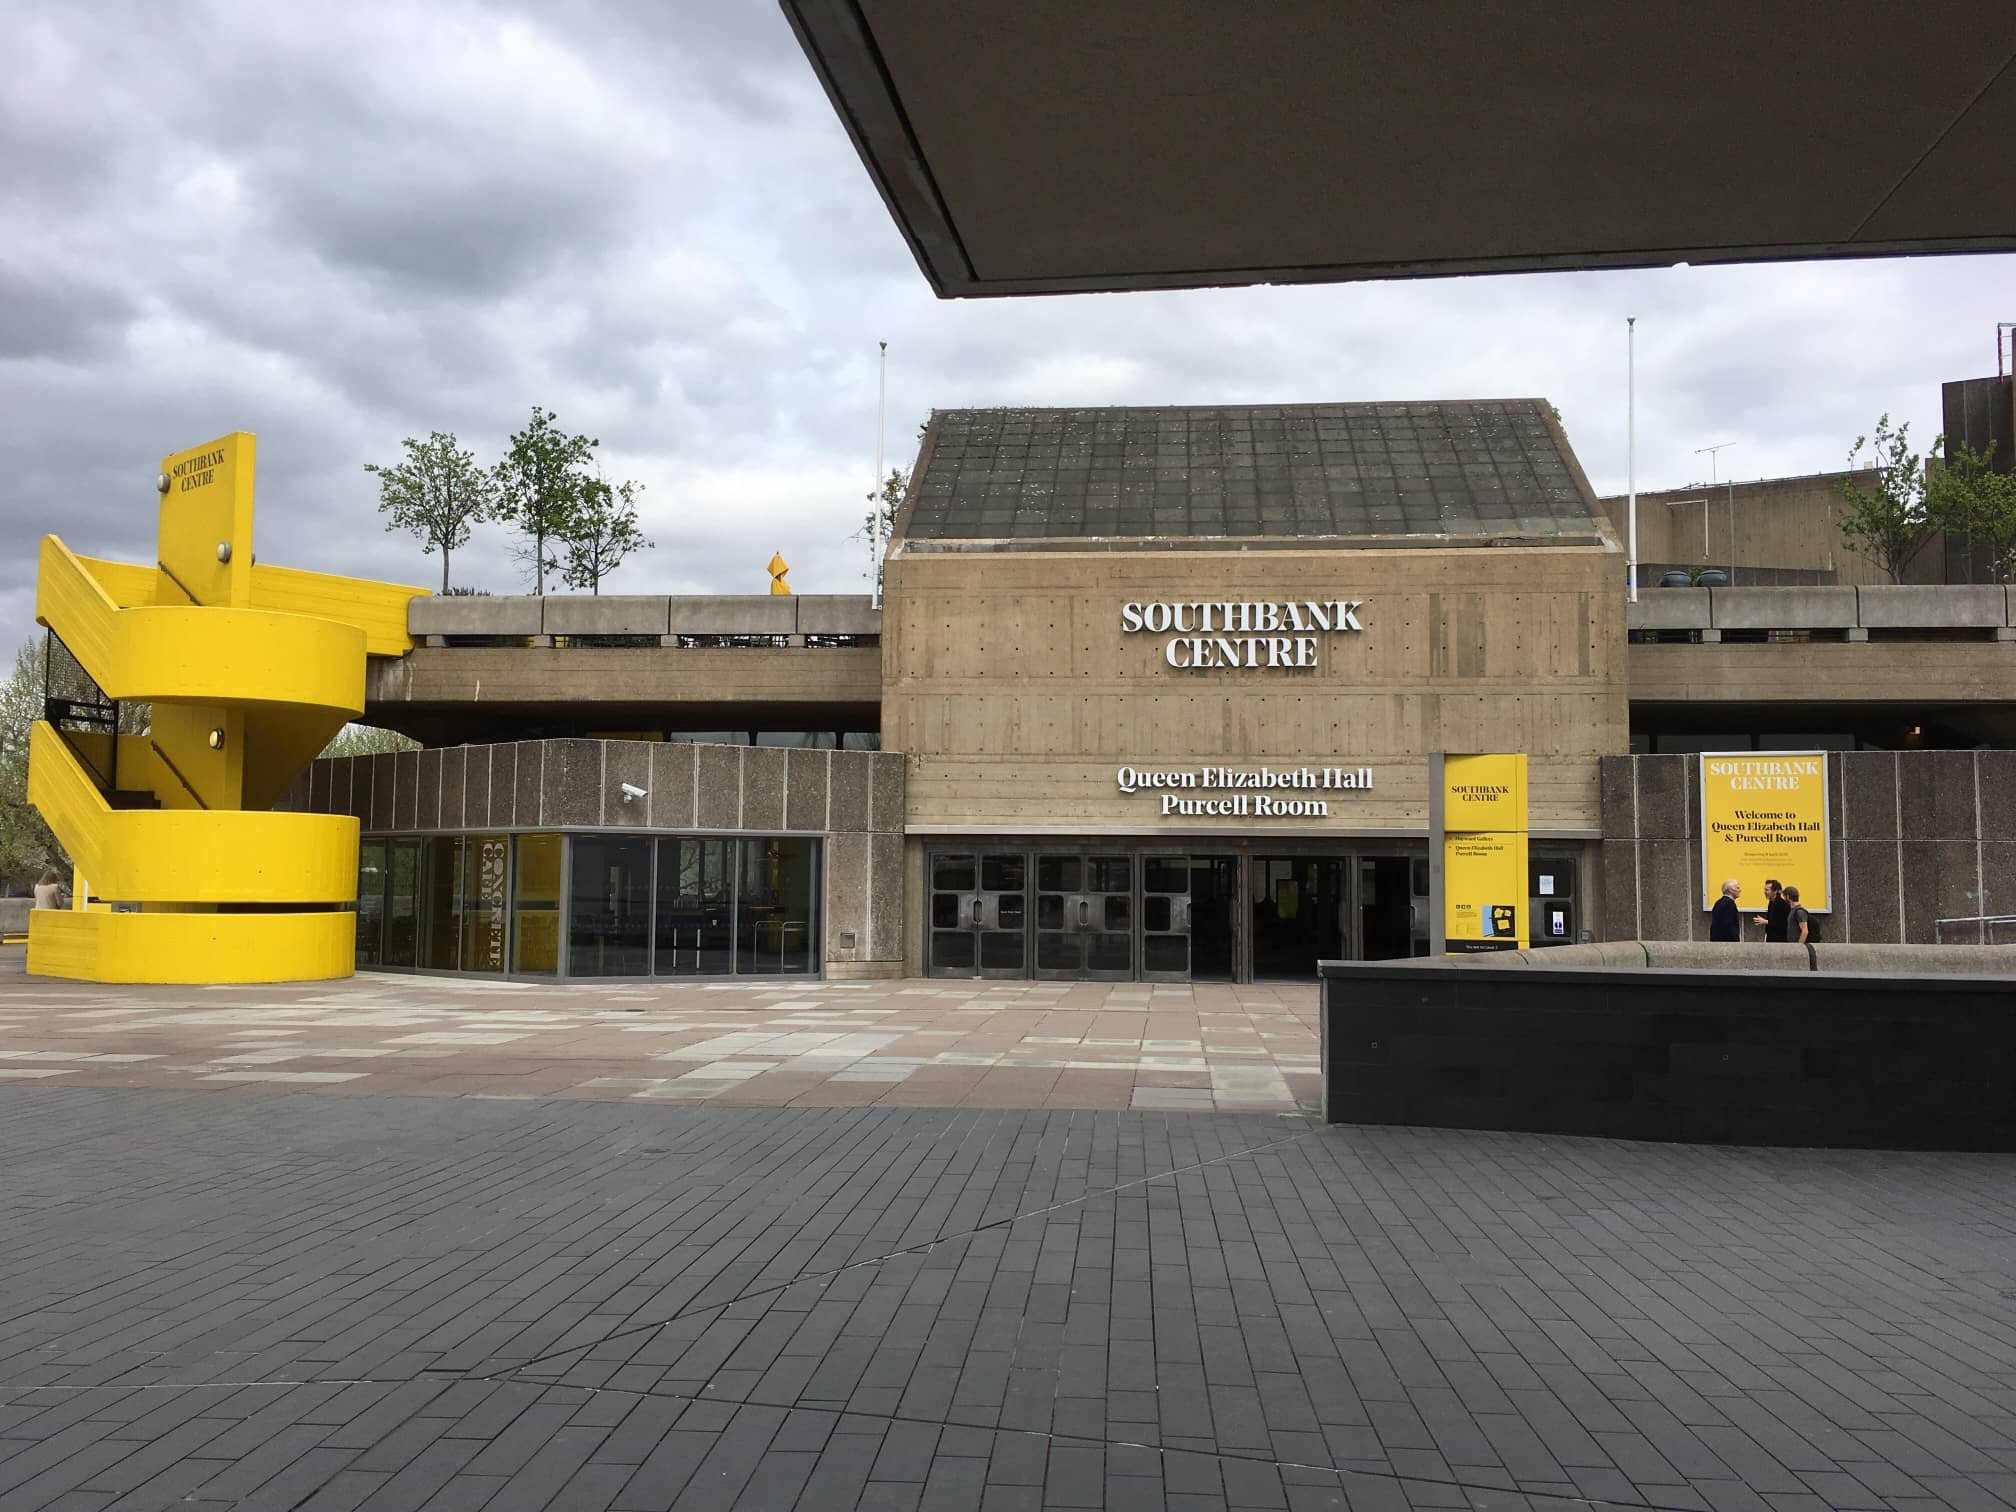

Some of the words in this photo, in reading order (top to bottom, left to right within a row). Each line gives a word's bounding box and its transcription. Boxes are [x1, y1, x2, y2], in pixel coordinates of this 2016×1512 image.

[173, 449, 224, 479] SOUTHBANK
[182, 469, 214, 492] CENTRE
[1122, 601, 1363, 632] SOUTHBANK
[1166, 638, 1318, 668] CENTRE
[1710, 761, 1818, 775] SOUTHBANK
[1117, 767, 1196, 793] Queen
[1201, 768, 1317, 789] Elizabeth
[1322, 768, 1373, 789] Hall
[1730, 776, 1799, 790] CENTRE
[1160, 795, 1249, 815] Purcell
[1254, 795, 1328, 816] Room
[1735, 810, 1783, 819] Welcome
[1785, 811, 1796, 819] to
[1711, 822, 1745, 832] Queen
[1747, 822, 1795, 831] Elizabeth
[1798, 822, 1820, 831] Hall
[1724, 834, 1733, 842] &
[1736, 833, 1773, 842] Purcell
[1775, 834, 1807, 842] Room
[482, 843, 494, 900] CAFE
[489, 843, 504, 966] CONCRETE
